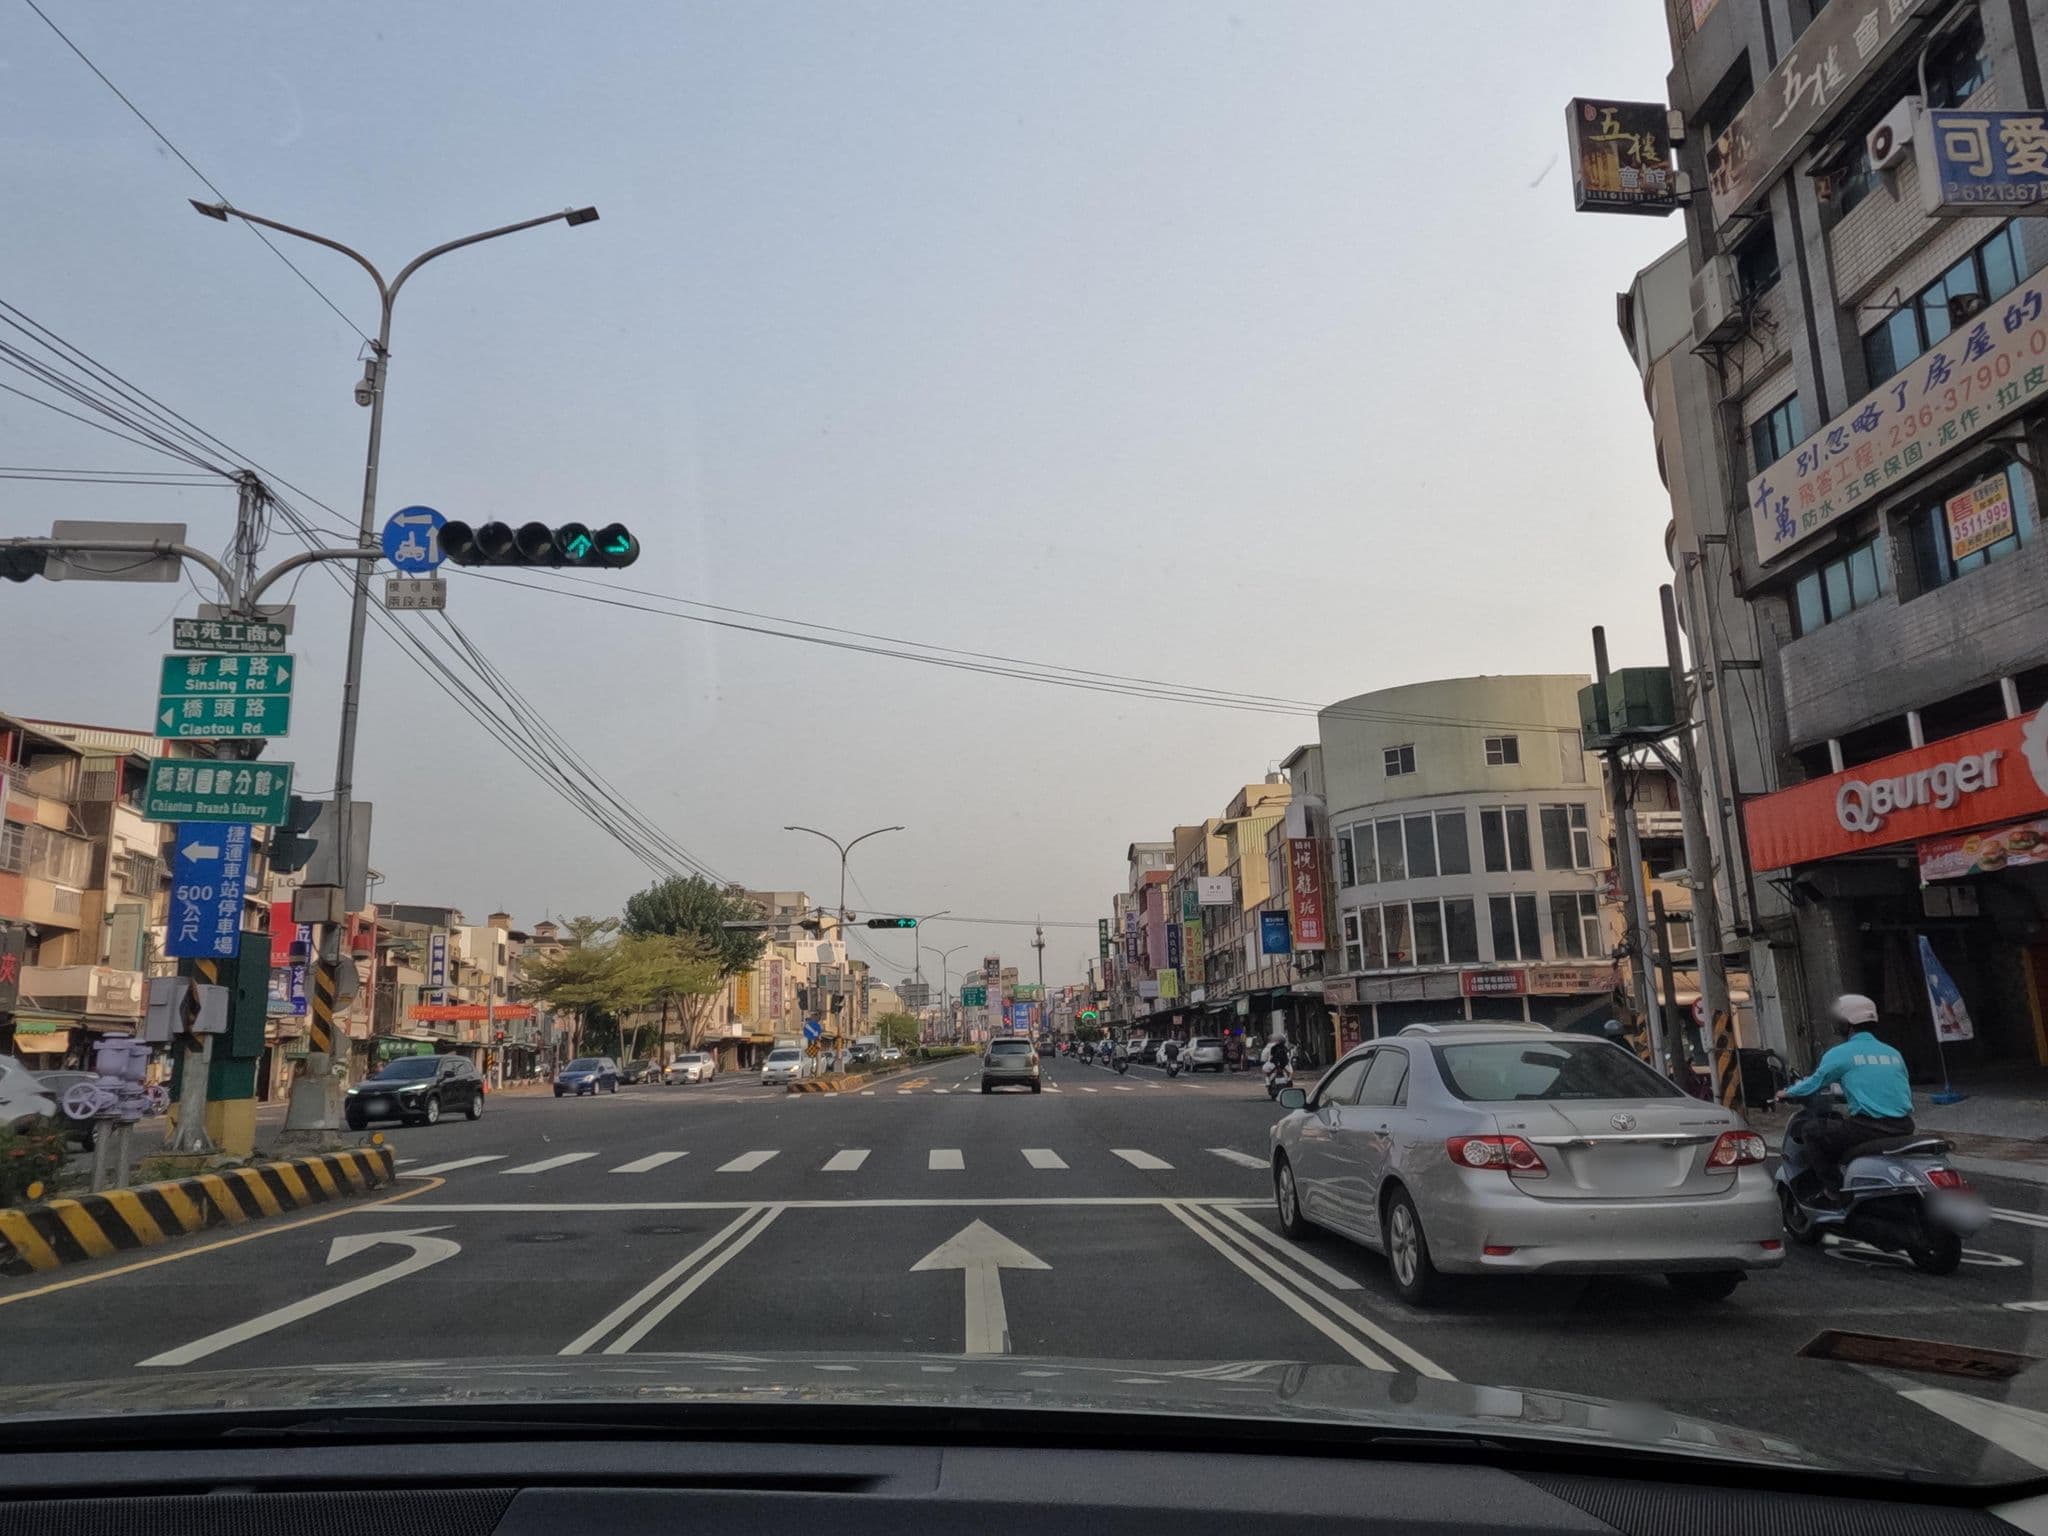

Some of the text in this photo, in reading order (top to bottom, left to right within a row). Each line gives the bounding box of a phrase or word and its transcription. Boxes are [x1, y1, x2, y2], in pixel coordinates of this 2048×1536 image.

[176, 621, 267, 643] 高苑工商
[187, 657, 269, 676] 新興路
[185, 679, 237, 693] Sinsing
[182, 699, 265, 718] 橋頭路
[179, 723, 234, 735] Ciaotou
[156, 766, 272, 796] 橋頭圖書分館
[196, 801, 230, 815] Branch
[232, 803, 268, 818] Library
[177, 885, 213, 901] 500
[212, 826, 246, 955] 捷運車站停車場
